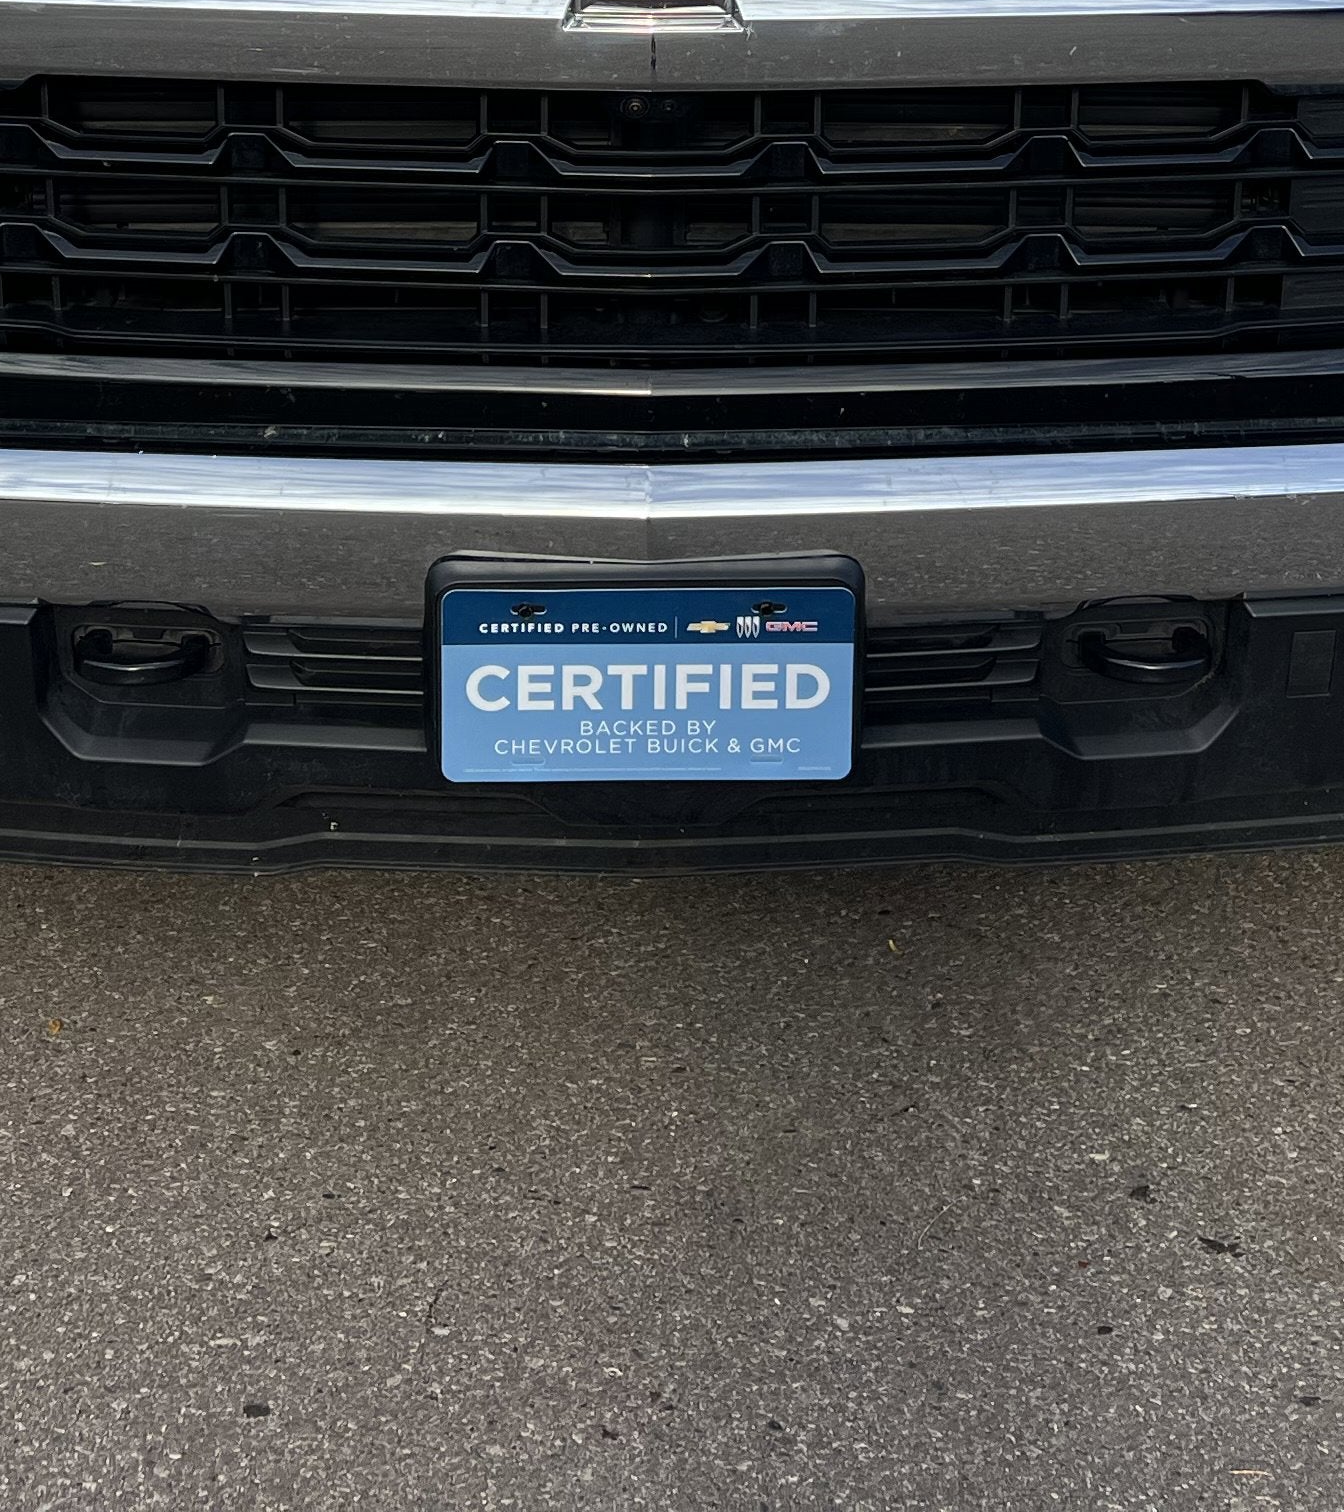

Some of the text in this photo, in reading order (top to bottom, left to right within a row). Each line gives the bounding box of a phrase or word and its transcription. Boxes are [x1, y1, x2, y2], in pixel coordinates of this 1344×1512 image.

[479, 622, 668, 634] CERTIFIED PRE-OWNED
[766, 621, 818, 632] GMC
[465, 663, 831, 712] CERTIFIED
[580, 720, 717, 736] BACKED BY
[494, 738, 801, 755] CHEVROLET BUICK & GMC
